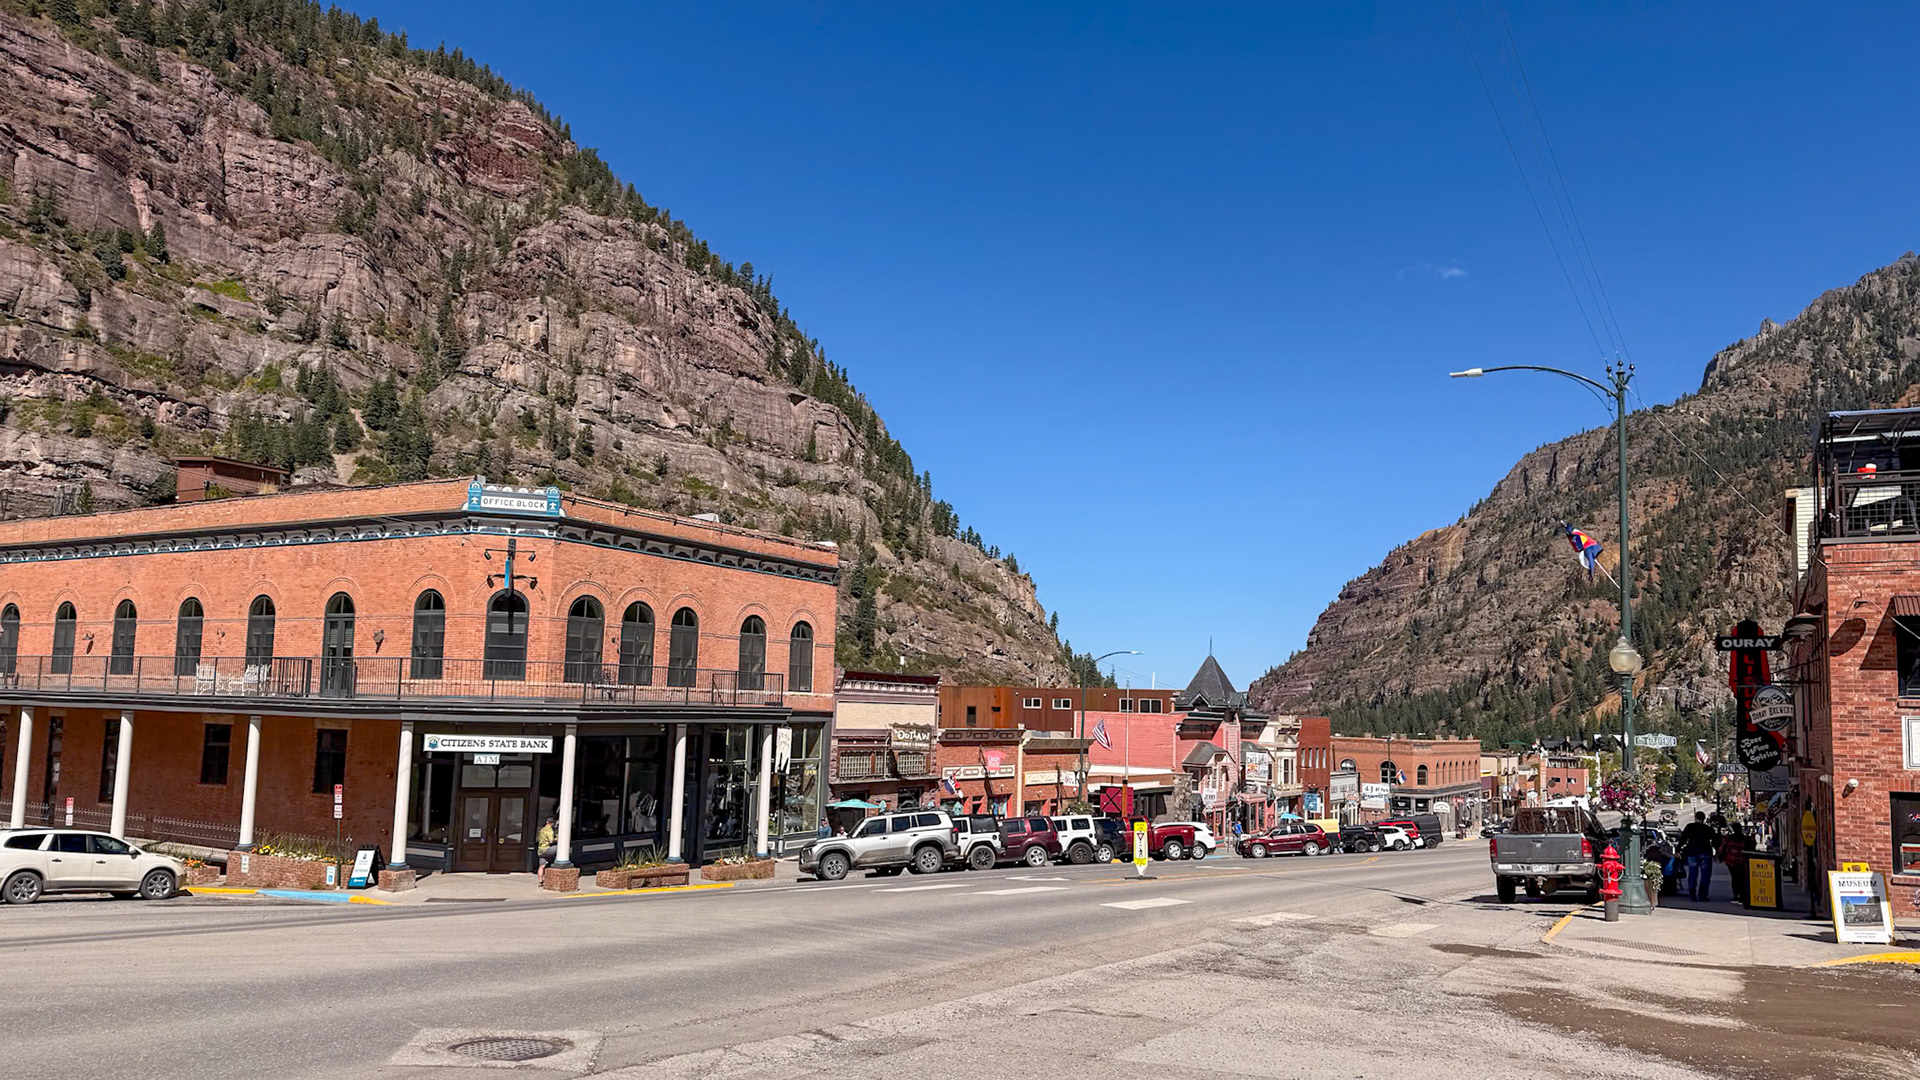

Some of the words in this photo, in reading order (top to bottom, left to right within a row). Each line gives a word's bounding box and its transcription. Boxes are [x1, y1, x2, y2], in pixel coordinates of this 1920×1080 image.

[483, 498, 514, 507] OFFICE
[516, 500, 545, 509] BLOCK
[1721, 638, 1775, 648] OURAY
[1768, 704, 1794, 716] BREWERY
[897, 729, 931, 741] OUTLAW
[440, 738, 486, 748] CITIZENS
[488, 739, 517, 748] STATE
[520, 740, 548, 749] BANK
[1740, 736, 1762, 749] Beer
[1743, 744, 1769, 757] Wine
[475, 755, 498, 764] ATM
[1747, 750, 1778, 764] Spirits
[1752, 871, 1773, 880] OUTSIDE
[1759, 879, 1766, 887] TO
[1838, 880, 1878, 888] MUSEUM
